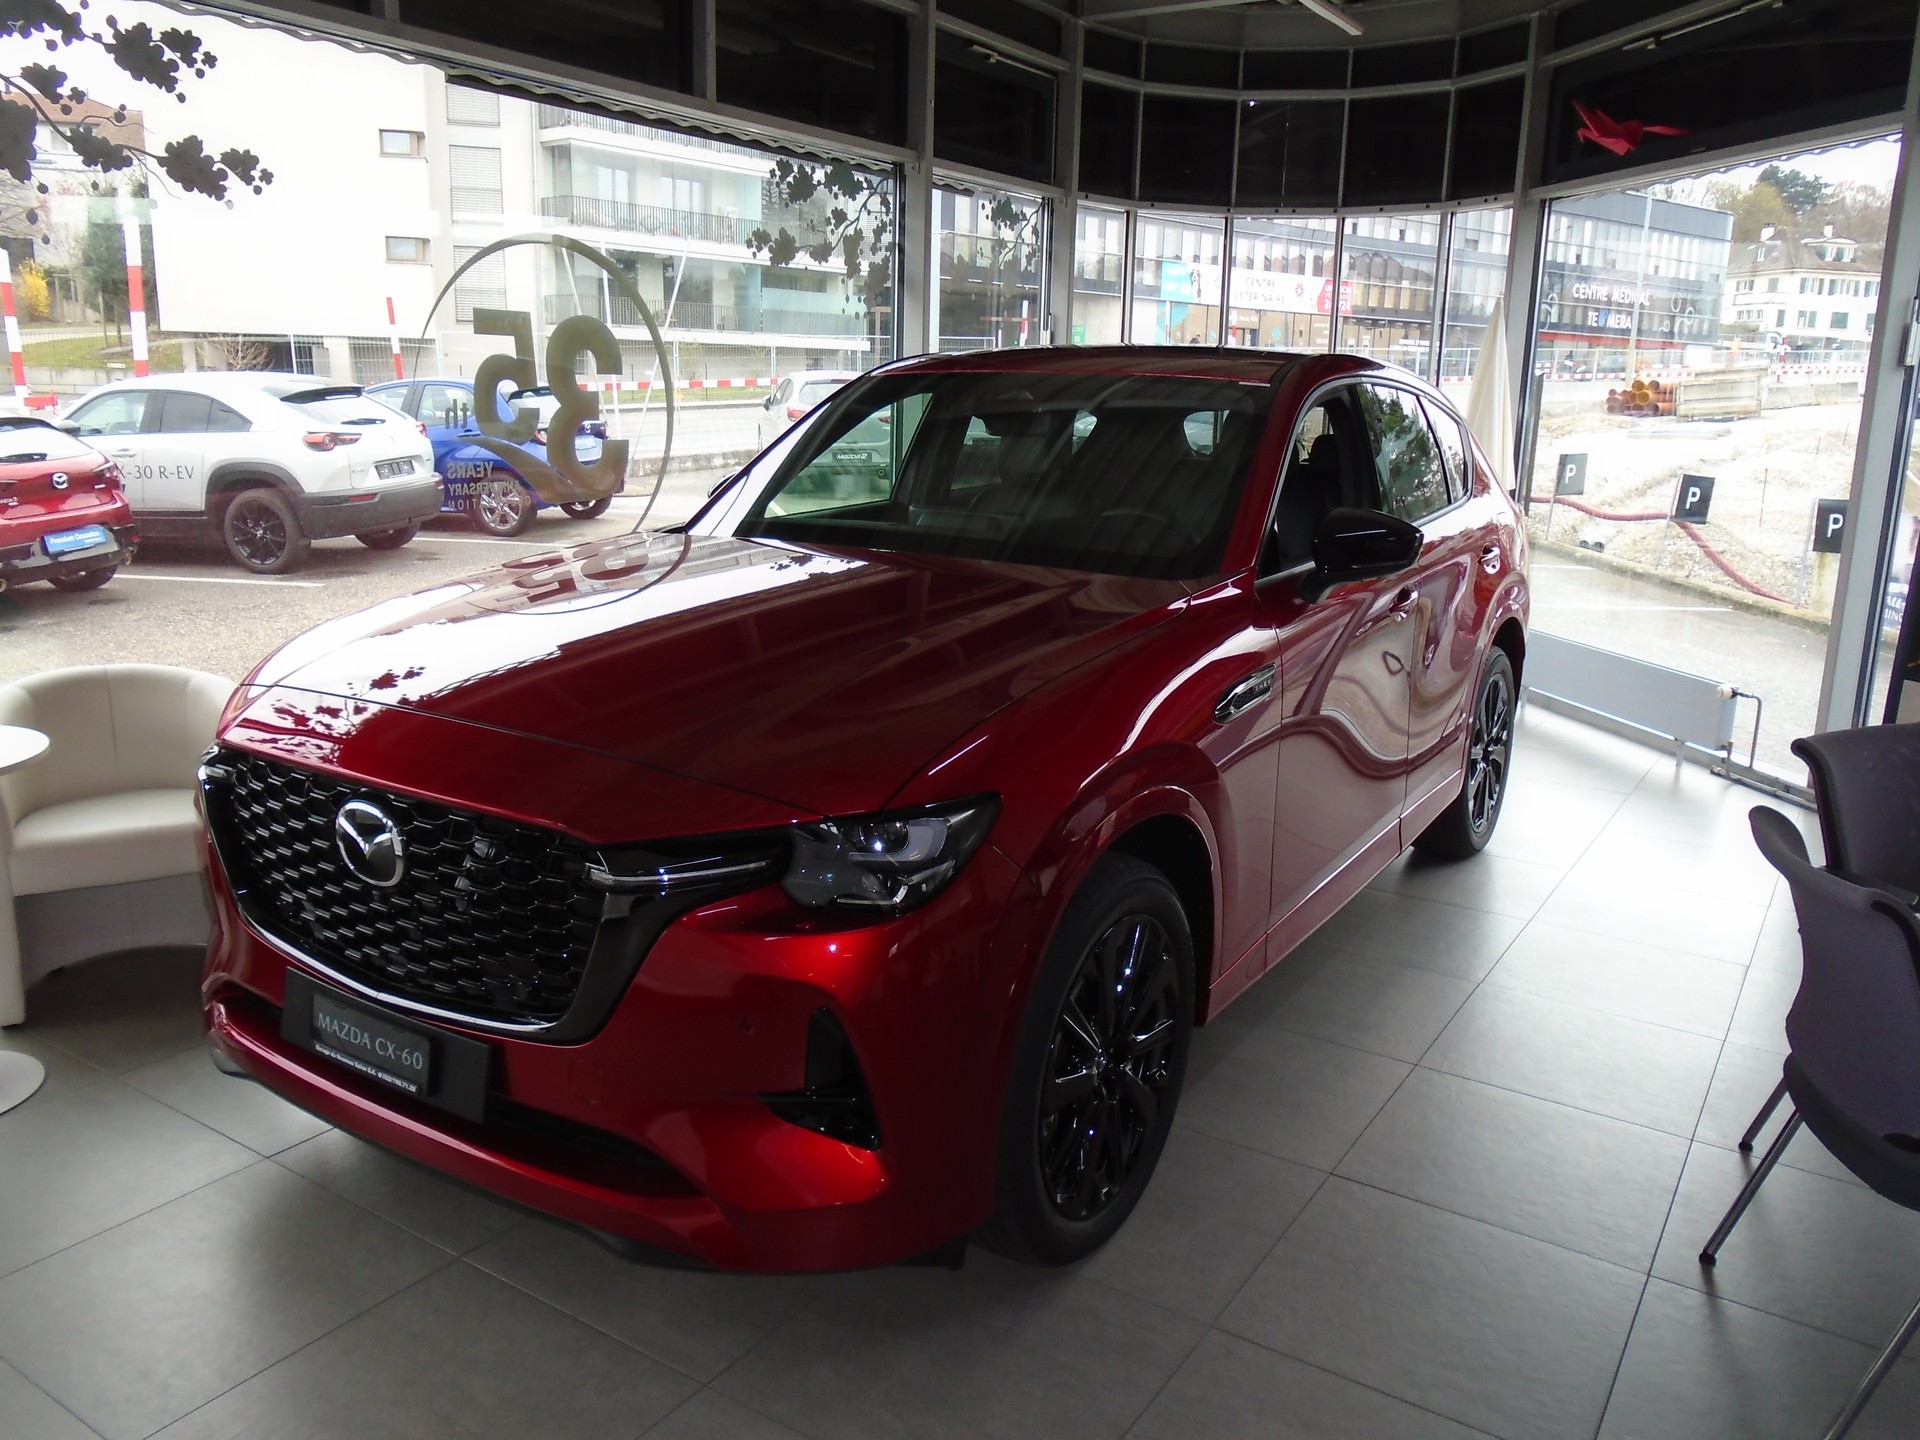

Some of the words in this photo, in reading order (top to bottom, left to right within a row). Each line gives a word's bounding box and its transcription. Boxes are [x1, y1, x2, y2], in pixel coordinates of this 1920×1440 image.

[1572, 283, 1609, 302] CENTRE
[119, 465, 153, 480] X-30
[158, 465, 195, 480] R-EV
[1565, 464, 1577, 484] P
[1685, 486, 1701, 510] P
[1826, 513, 1844, 538] P
[318, 1013, 371, 1049] MAZDA
[375, 1038, 423, 1070] CX-60
